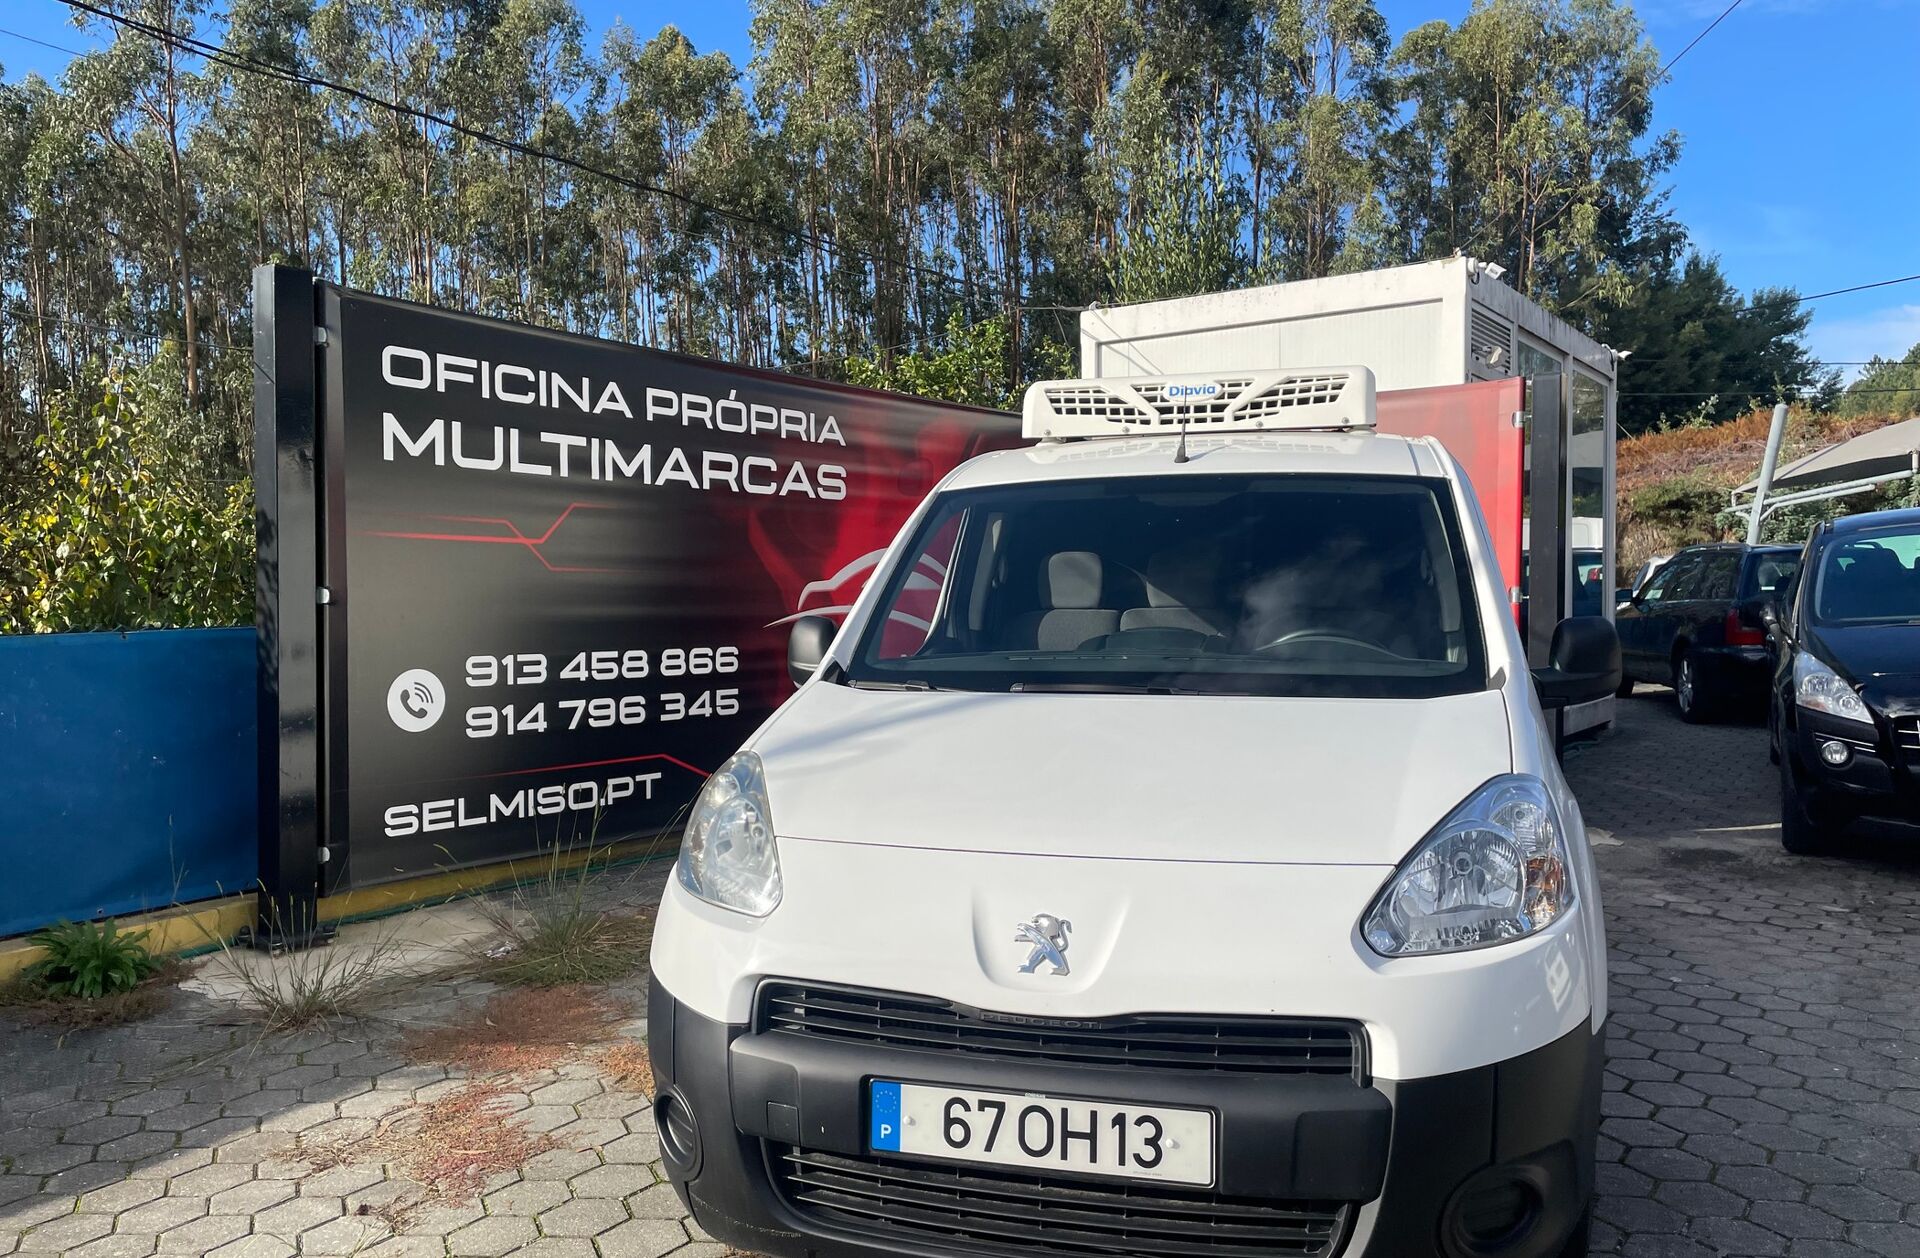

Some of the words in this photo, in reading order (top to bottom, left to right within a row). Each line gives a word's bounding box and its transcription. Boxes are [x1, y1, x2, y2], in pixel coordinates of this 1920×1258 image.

[381, 345, 634, 419] OFICINA
[646, 387, 847, 447] PRÓPRIA
[1169, 384, 1216, 397] Diavia
[382, 412, 848, 501] MULTIMARCAS
[465, 653, 548, 687] 913
[559, 649, 649, 682] 458
[660, 646, 740, 677] 866
[465, 702, 548, 739] 914
[558, 695, 646, 730] 796
[660, 688, 740, 722] 345
[384, 772, 662, 838] SELMISO.PT
[880, 1124, 892, 1139] P
